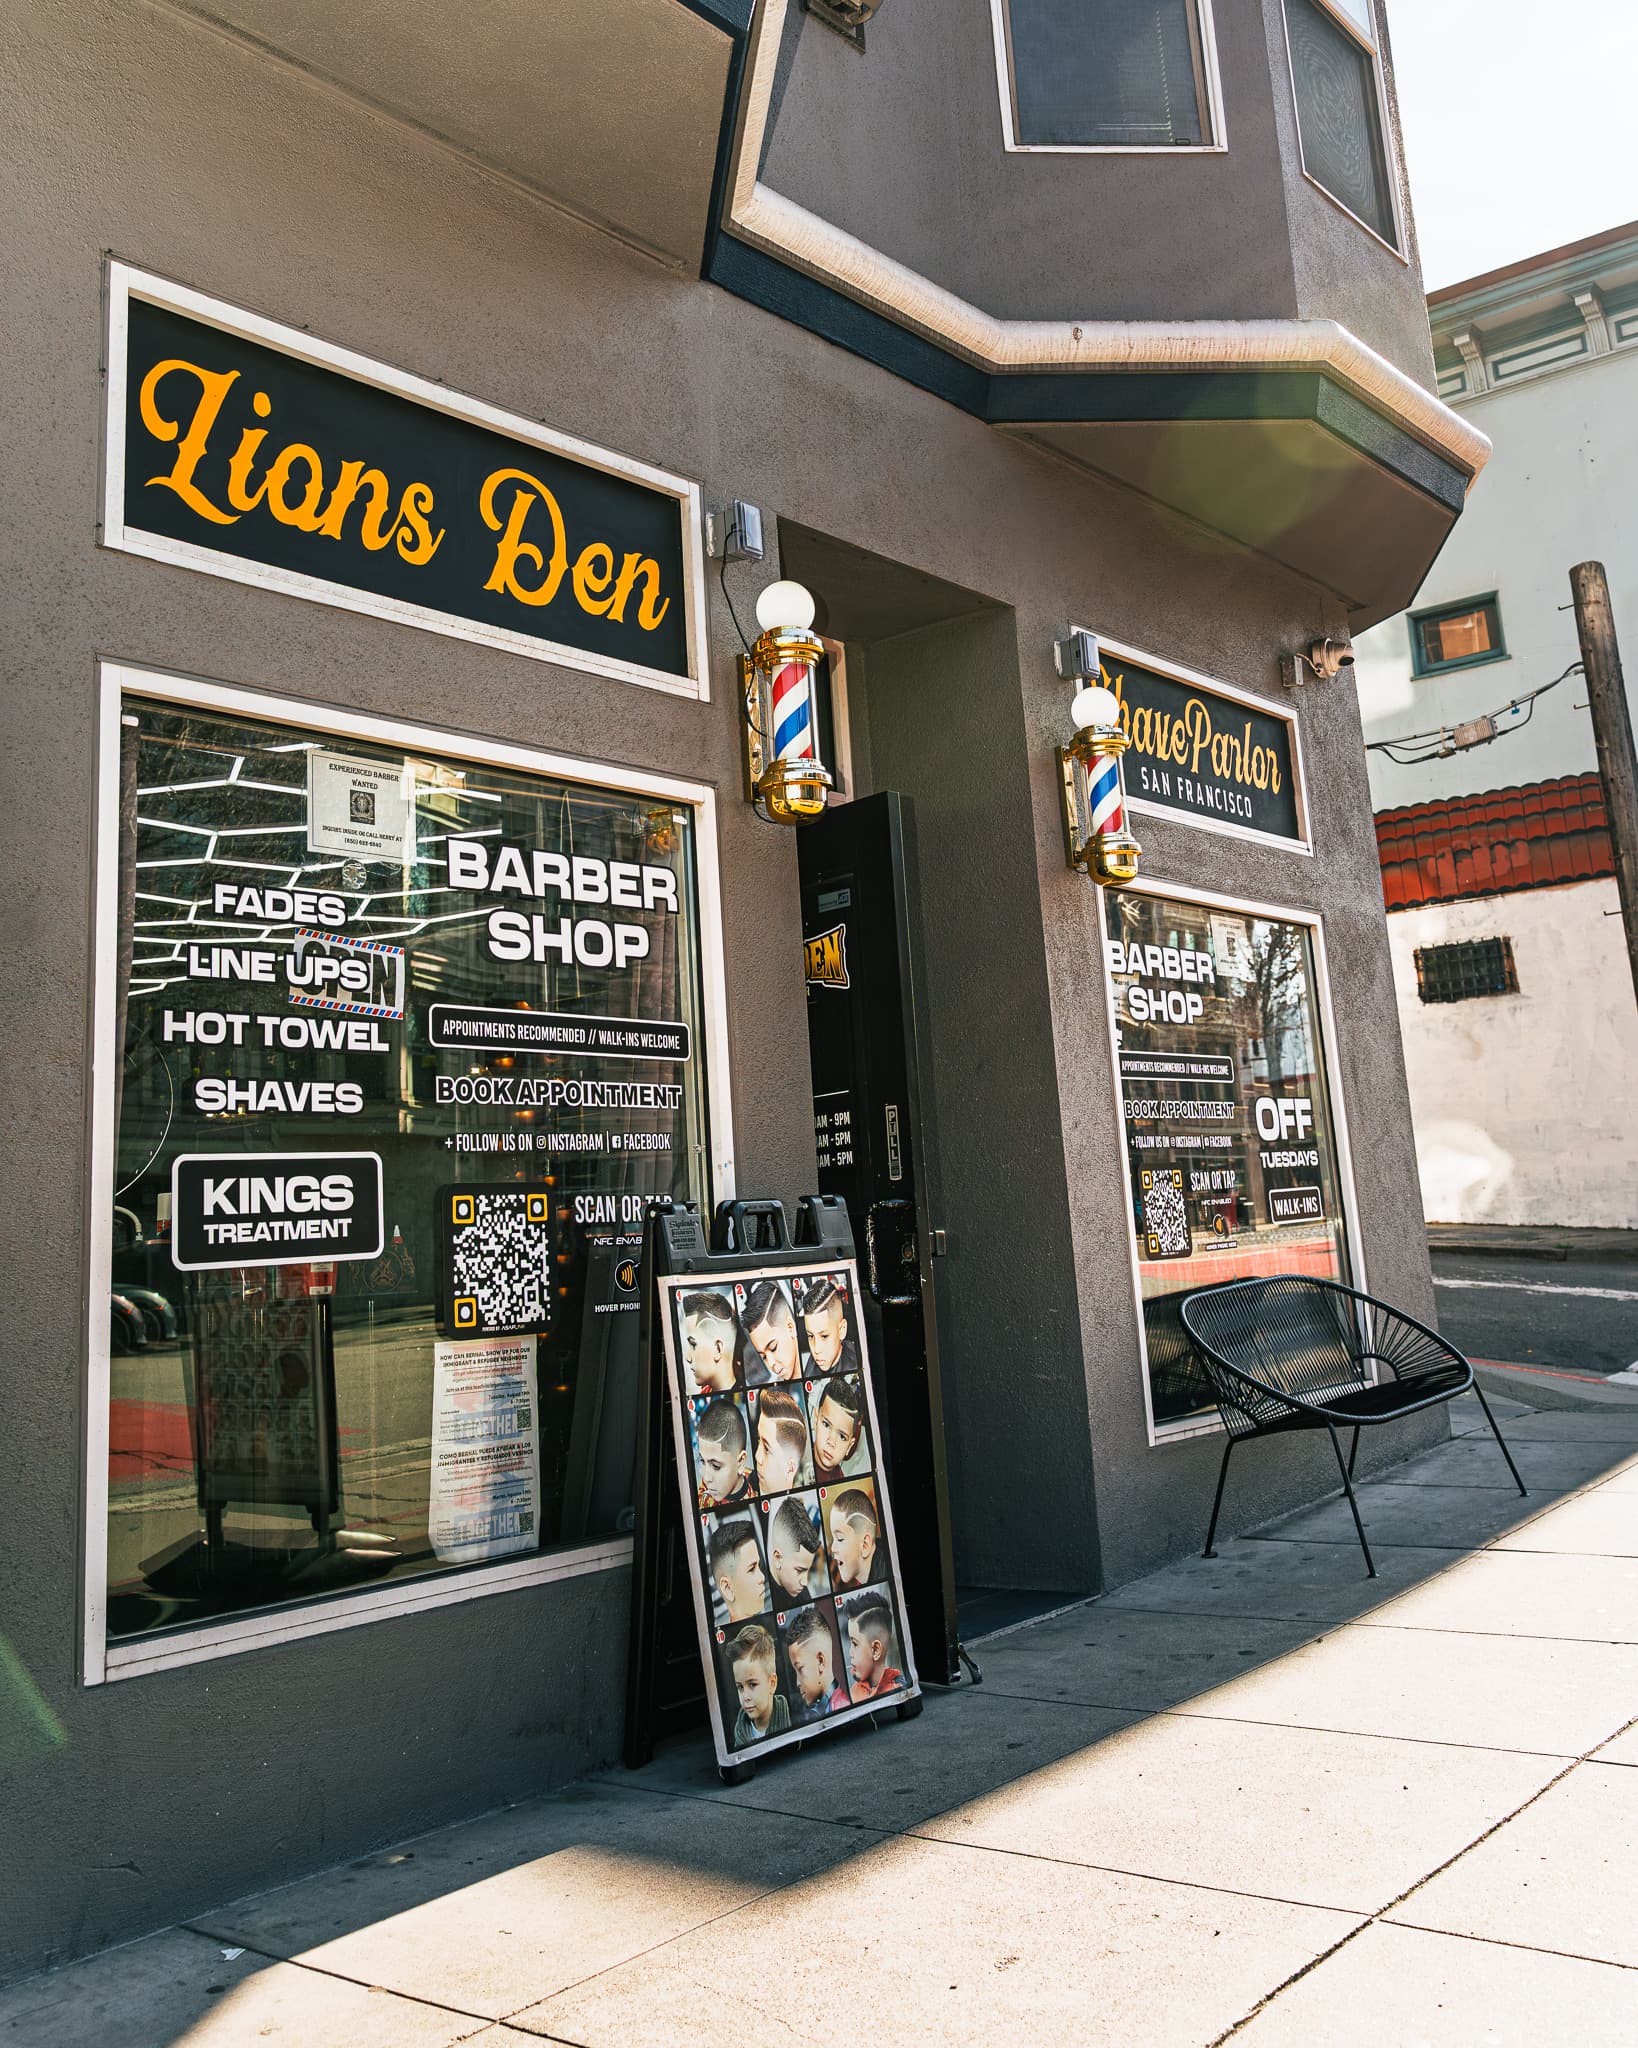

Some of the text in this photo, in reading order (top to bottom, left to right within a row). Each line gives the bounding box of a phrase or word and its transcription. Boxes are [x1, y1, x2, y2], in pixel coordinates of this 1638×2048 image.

[139, 359, 670, 632] Lions Den
[1184, 698, 1282, 796] Parlor
[328, 763, 400, 783] EXPERIENCED BARBER
[351, 779, 379, 790] WANTED
[1140, 766, 1253, 819] SAN FRANCISCO
[366, 831, 379, 839] CALL
[447, 838, 679, 913] BARBER
[213, 882, 347, 927] FADES
[487, 910, 650, 968] SHOP
[188, 945, 276, 982] LINE
[285, 953, 370, 990] UPS
[1106, 939, 1215, 984] BARBER
[1127, 986, 1204, 1025] SHOP
[163, 1009, 390, 1052] HOT TOWEL
[442, 1019, 516, 1040] APPOINTMENTS
[517, 1023, 586, 1044] RECOMMENDED
[598, 1029, 640, 1048] WALK-INS
[640, 1032, 680, 1050] WELCOME
[1121, 1060, 1154, 1072] APPOINTMENTS
[1154, 1061, 1186, 1073] RECOMMENDED
[1190, 1063, 1210, 1075] WALK-INS
[1210, 1065, 1230, 1075] WELCOME
[194, 1078, 364, 1114] SHAVES
[435, 1075, 683, 1109] BOOK APPOINTMENT
[834, 1111, 851, 1126] 9PM
[1124, 1100, 1234, 1119] BOOK APPOINTMENT
[1255, 1097, 1312, 1142] OFF
[456, 1133, 499, 1152] FOLLOW
[502, 1134, 515, 1152] US
[518, 1133, 533, 1152] ON
[548, 1133, 604, 1151] INSTAGRAM
[623, 1133, 671, 1150] FACEBOOK
[835, 1131, 851, 1146] 5PM
[888, 1110, 898, 1160] PULL
[1135, 1135, 1154, 1149] FOLLOW
[1155, 1136, 1162, 1148] US
[1162, 1136, 1170, 1148] ON
[1176, 1135, 1202, 1148] INSTAGRAM
[1209, 1135, 1233, 1148] FACEBOOK
[837, 1151, 854, 1166] 5PM
[1259, 1150, 1319, 1169] TUESDAYS
[1190, 1169, 1236, 1192] SCAN OR TAP
[203, 1174, 355, 1216] KINGS
[575, 1195, 642, 1223] SCAN OR
[1274, 1196, 1319, 1217] WALK-INS
[203, 1218, 353, 1245] TREATMENT
[593, 1237, 614, 1246] NFC
[594, 1303, 619, 1313] HOVER
